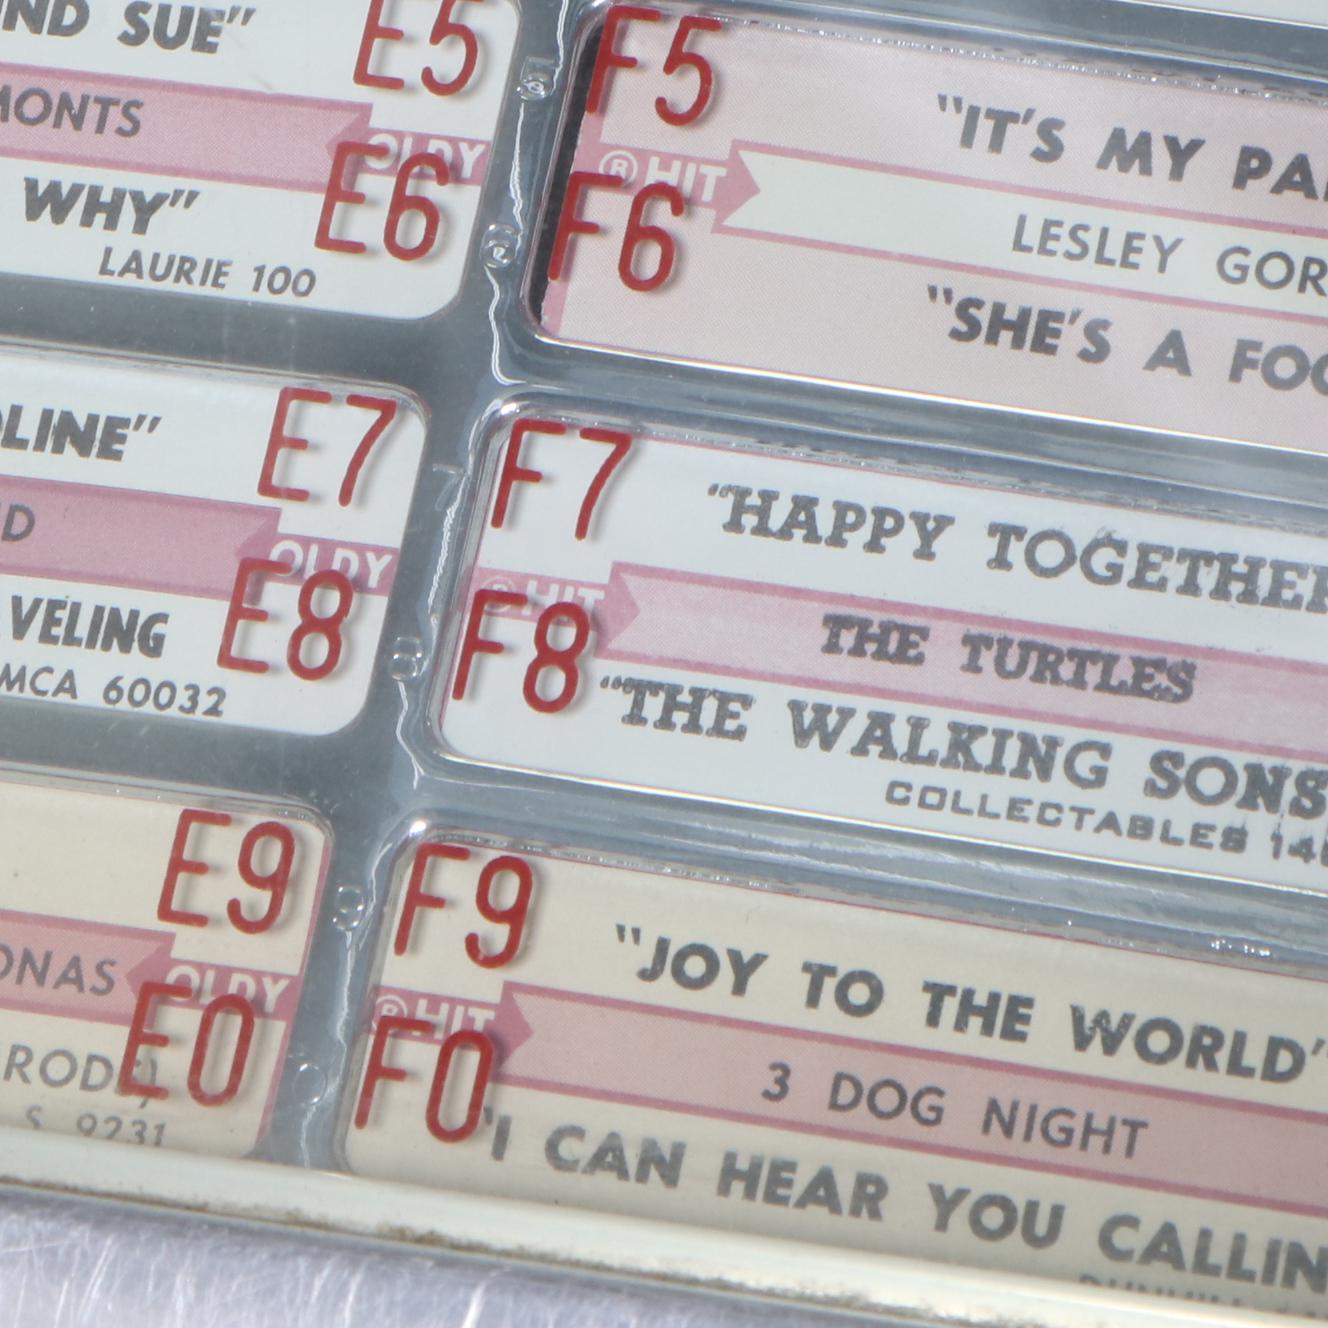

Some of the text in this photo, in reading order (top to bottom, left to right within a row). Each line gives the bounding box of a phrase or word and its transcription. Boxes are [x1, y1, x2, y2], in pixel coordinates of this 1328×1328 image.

[116, 0, 257, 55] SUE"
[584, 4, 721, 126] F5
[937, 93, 1066, 164] "IT'S
[1095, 126, 1207, 183] MY
[23, 175, 201, 236] WHY"
[313, 141, 449, 261] E6
[549, 174, 685, 292] F6
[1012, 213, 1184, 274] LESLEY
[98, 245, 317, 298] LAURIE 100
[926, 284, 1113, 364] "SHE'S
[1142, 328, 1193, 378] A
[257, 387, 396, 507] E7
[490, 420, 633, 541] F7
[707, 482, 956, 562] "HAPPY
[216, 560, 353, 680] E8
[451, 589, 590, 713] F8
[820, 612, 1198, 704] THE TURTLES
[102, 674, 227, 718] 60032
[599, 674, 757, 742] "THE
[786, 698, 1114, 790] WALKING
[156, 809, 296, 934] E9
[884, 779, 1250, 854] COLLECTABLES
[394, 843, 530, 967] F9
[615, 922, 770, 998] "JOY
[800, 960, 886, 1019] TO
[921, 979, 1036, 1044] THE
[116, 983, 255, 1107] E0
[355, 1018, 493, 1142] F0
[760, 1060, 1150, 1159] 3 DOG NIGHT
[544, 1124, 687, 1189] CAN
[716, 1150, 889, 1221] HEAR
[927, 1182, 1066, 1250] YOU
